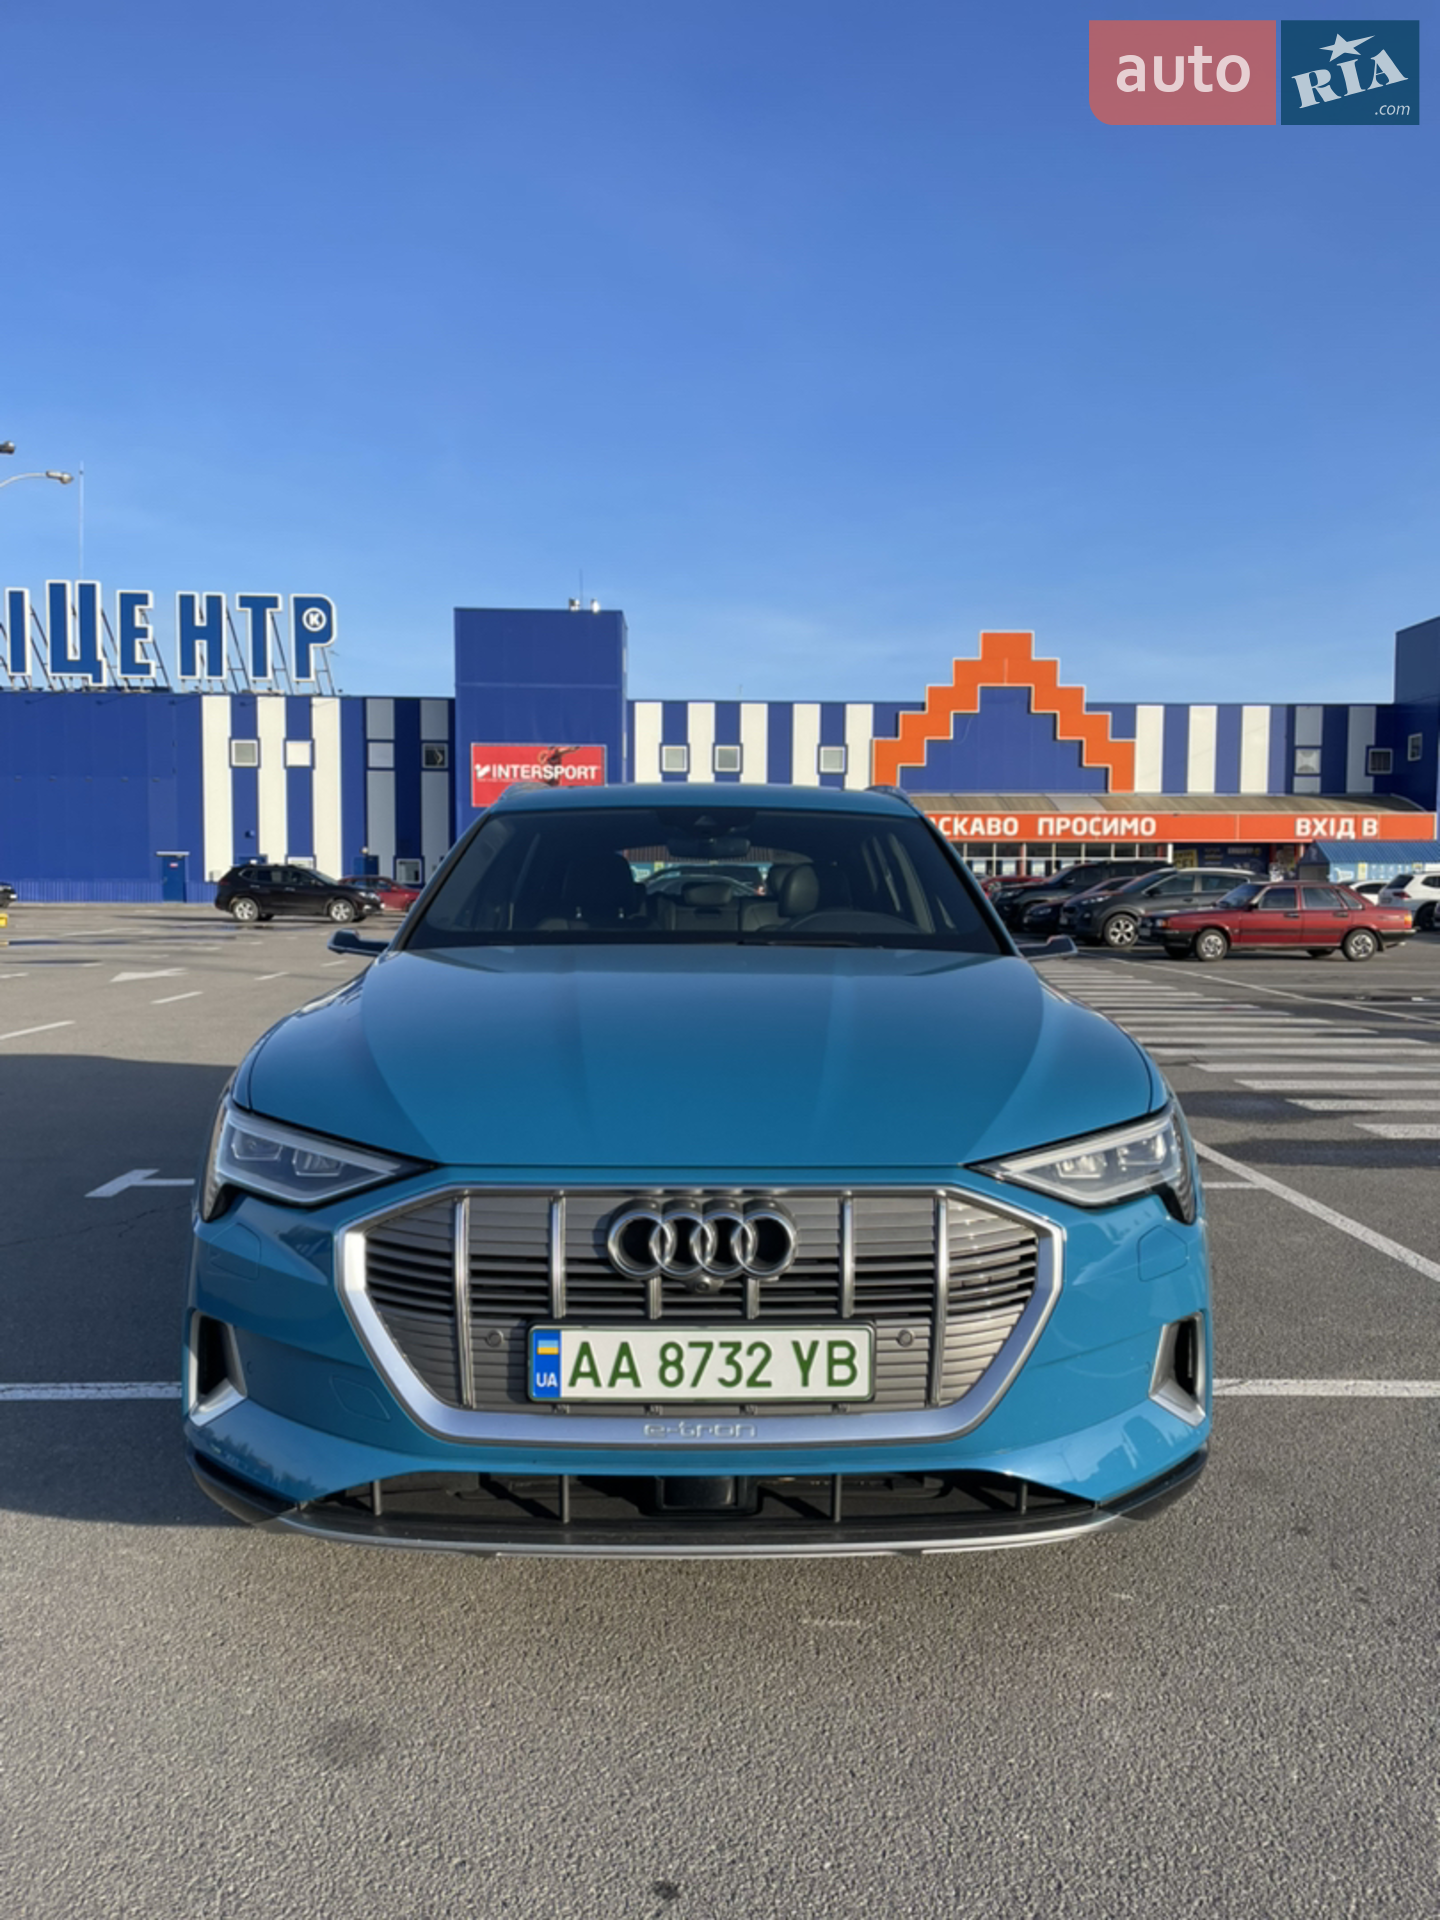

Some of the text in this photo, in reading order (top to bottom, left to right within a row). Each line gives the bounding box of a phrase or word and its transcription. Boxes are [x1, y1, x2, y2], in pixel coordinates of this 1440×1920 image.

[491, 763, 600, 780] INTERSPORT
[929, 816, 1157, 837] СКАВО ПРОСИМО
[1295, 816, 1378, 840] ВХІД В
[568, 1340, 859, 1388] AA 8732 YB
[536, 1372, 558, 1388] UA
[643, 1421, 758, 1438] e-tron
